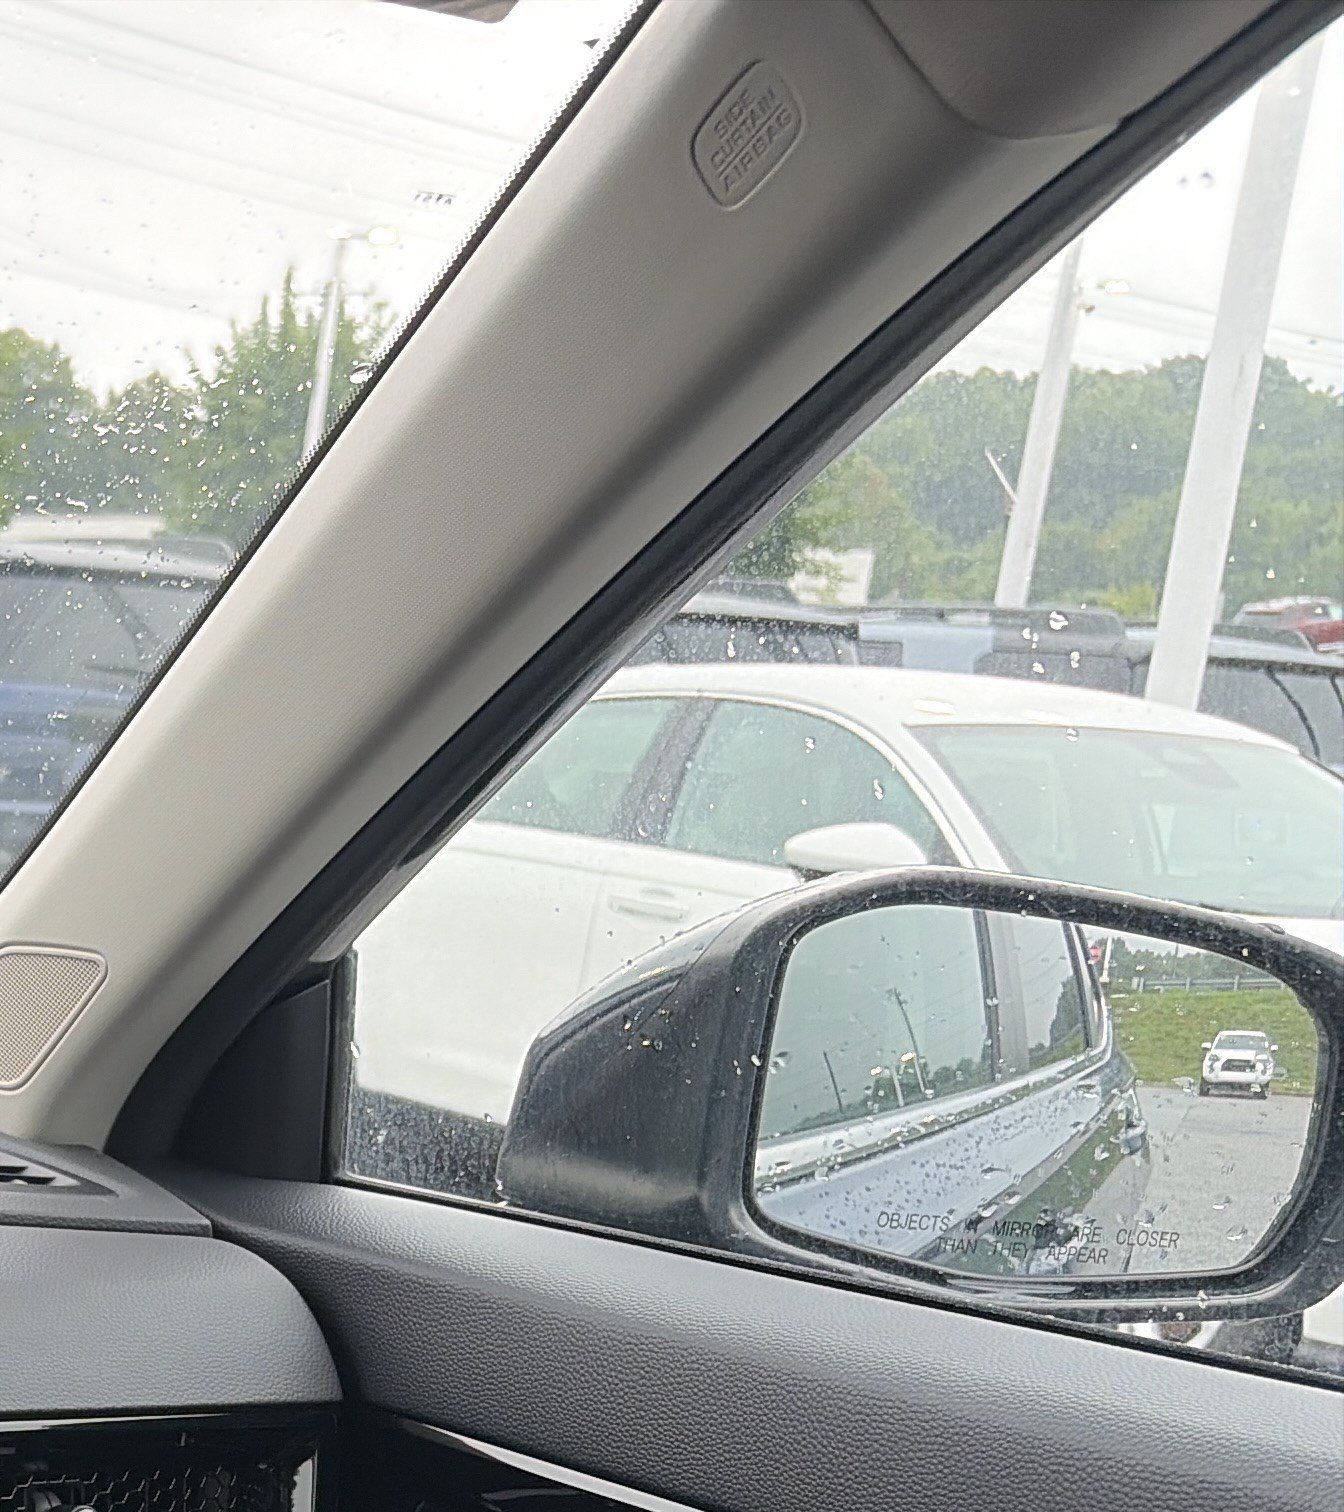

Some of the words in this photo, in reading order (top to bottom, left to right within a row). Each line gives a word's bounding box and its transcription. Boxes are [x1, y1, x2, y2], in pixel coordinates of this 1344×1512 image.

[877, 1211, 950, 1232] OBJECTS
[1116, 1228, 1181, 1249] CLOSER
[936, 1236, 978, 1254] THAN
[1045, 1244, 1109, 1265] APPEAR
